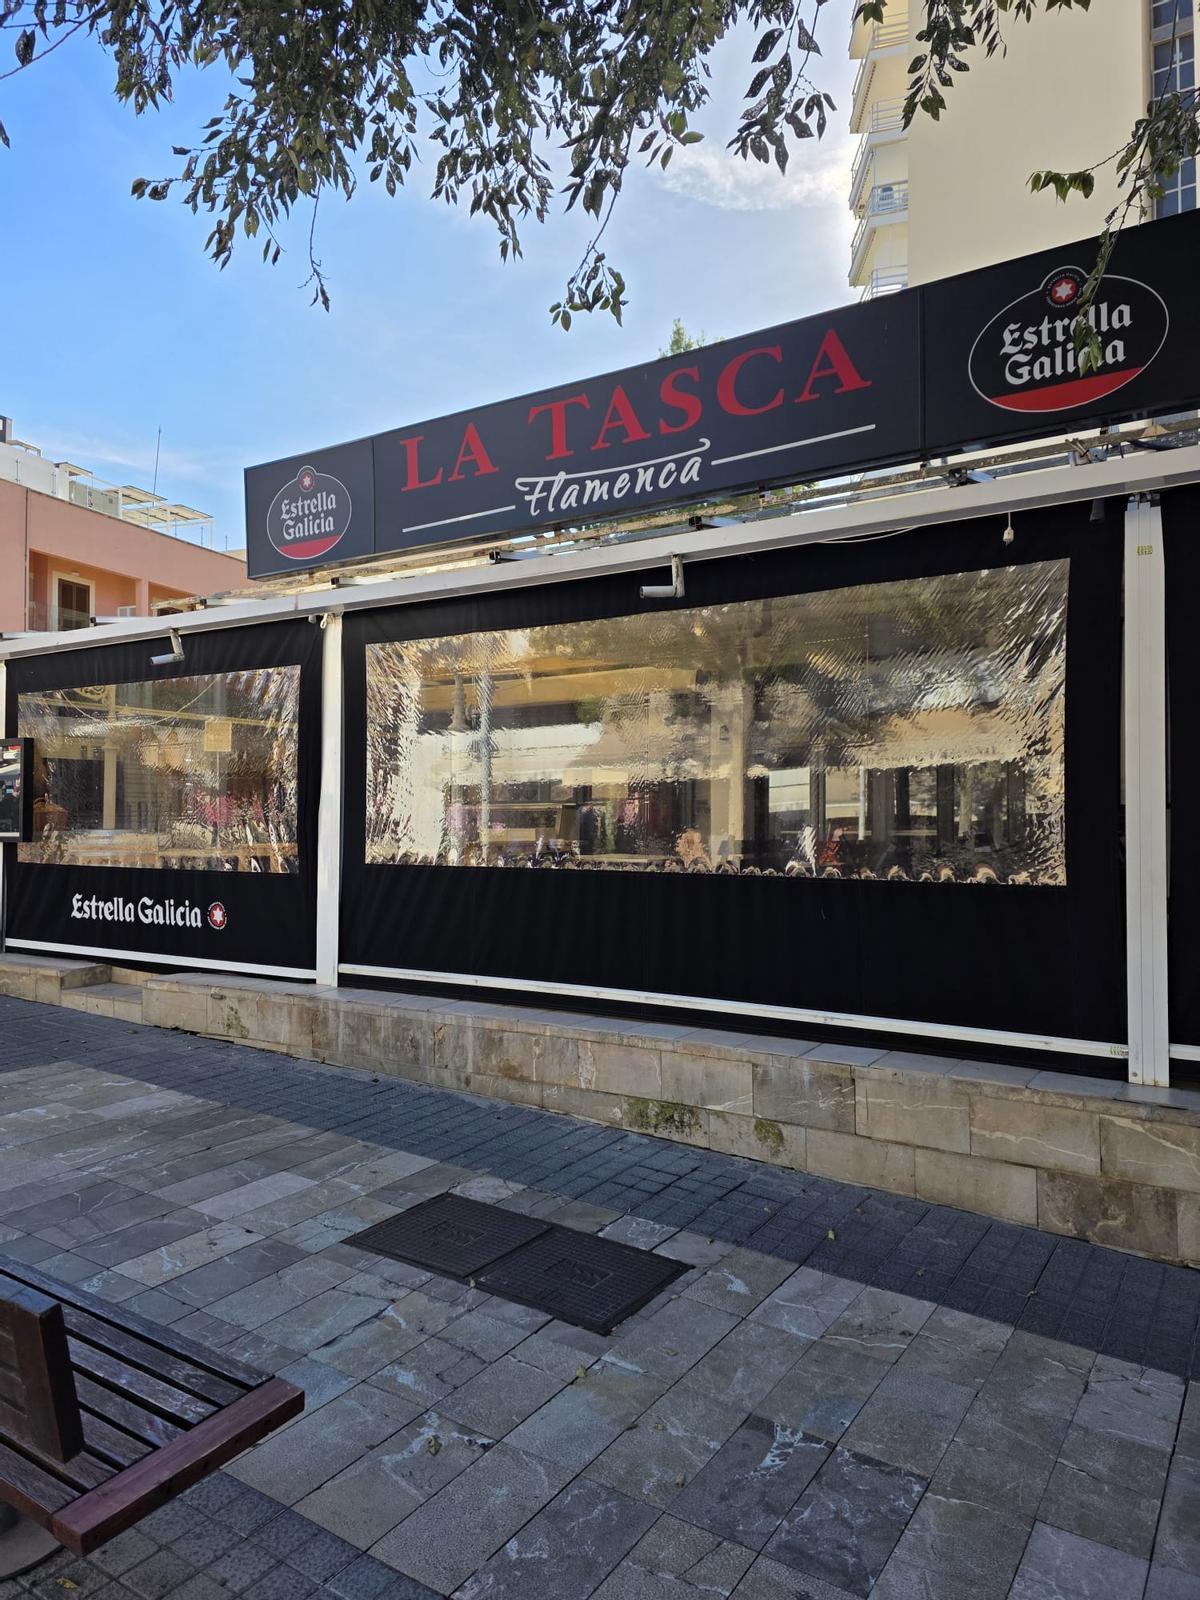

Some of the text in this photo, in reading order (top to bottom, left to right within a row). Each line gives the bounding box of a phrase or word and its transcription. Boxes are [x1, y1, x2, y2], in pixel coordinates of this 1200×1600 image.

[402, 330, 871, 492] LA TASCA
[514, 438, 712, 517] Flamenca
[280, 491, 337, 520] Estrella
[283, 513, 335, 540] Galicia
[70, 893, 135, 923] Estrella
[137, 896, 202, 928] Galicia
